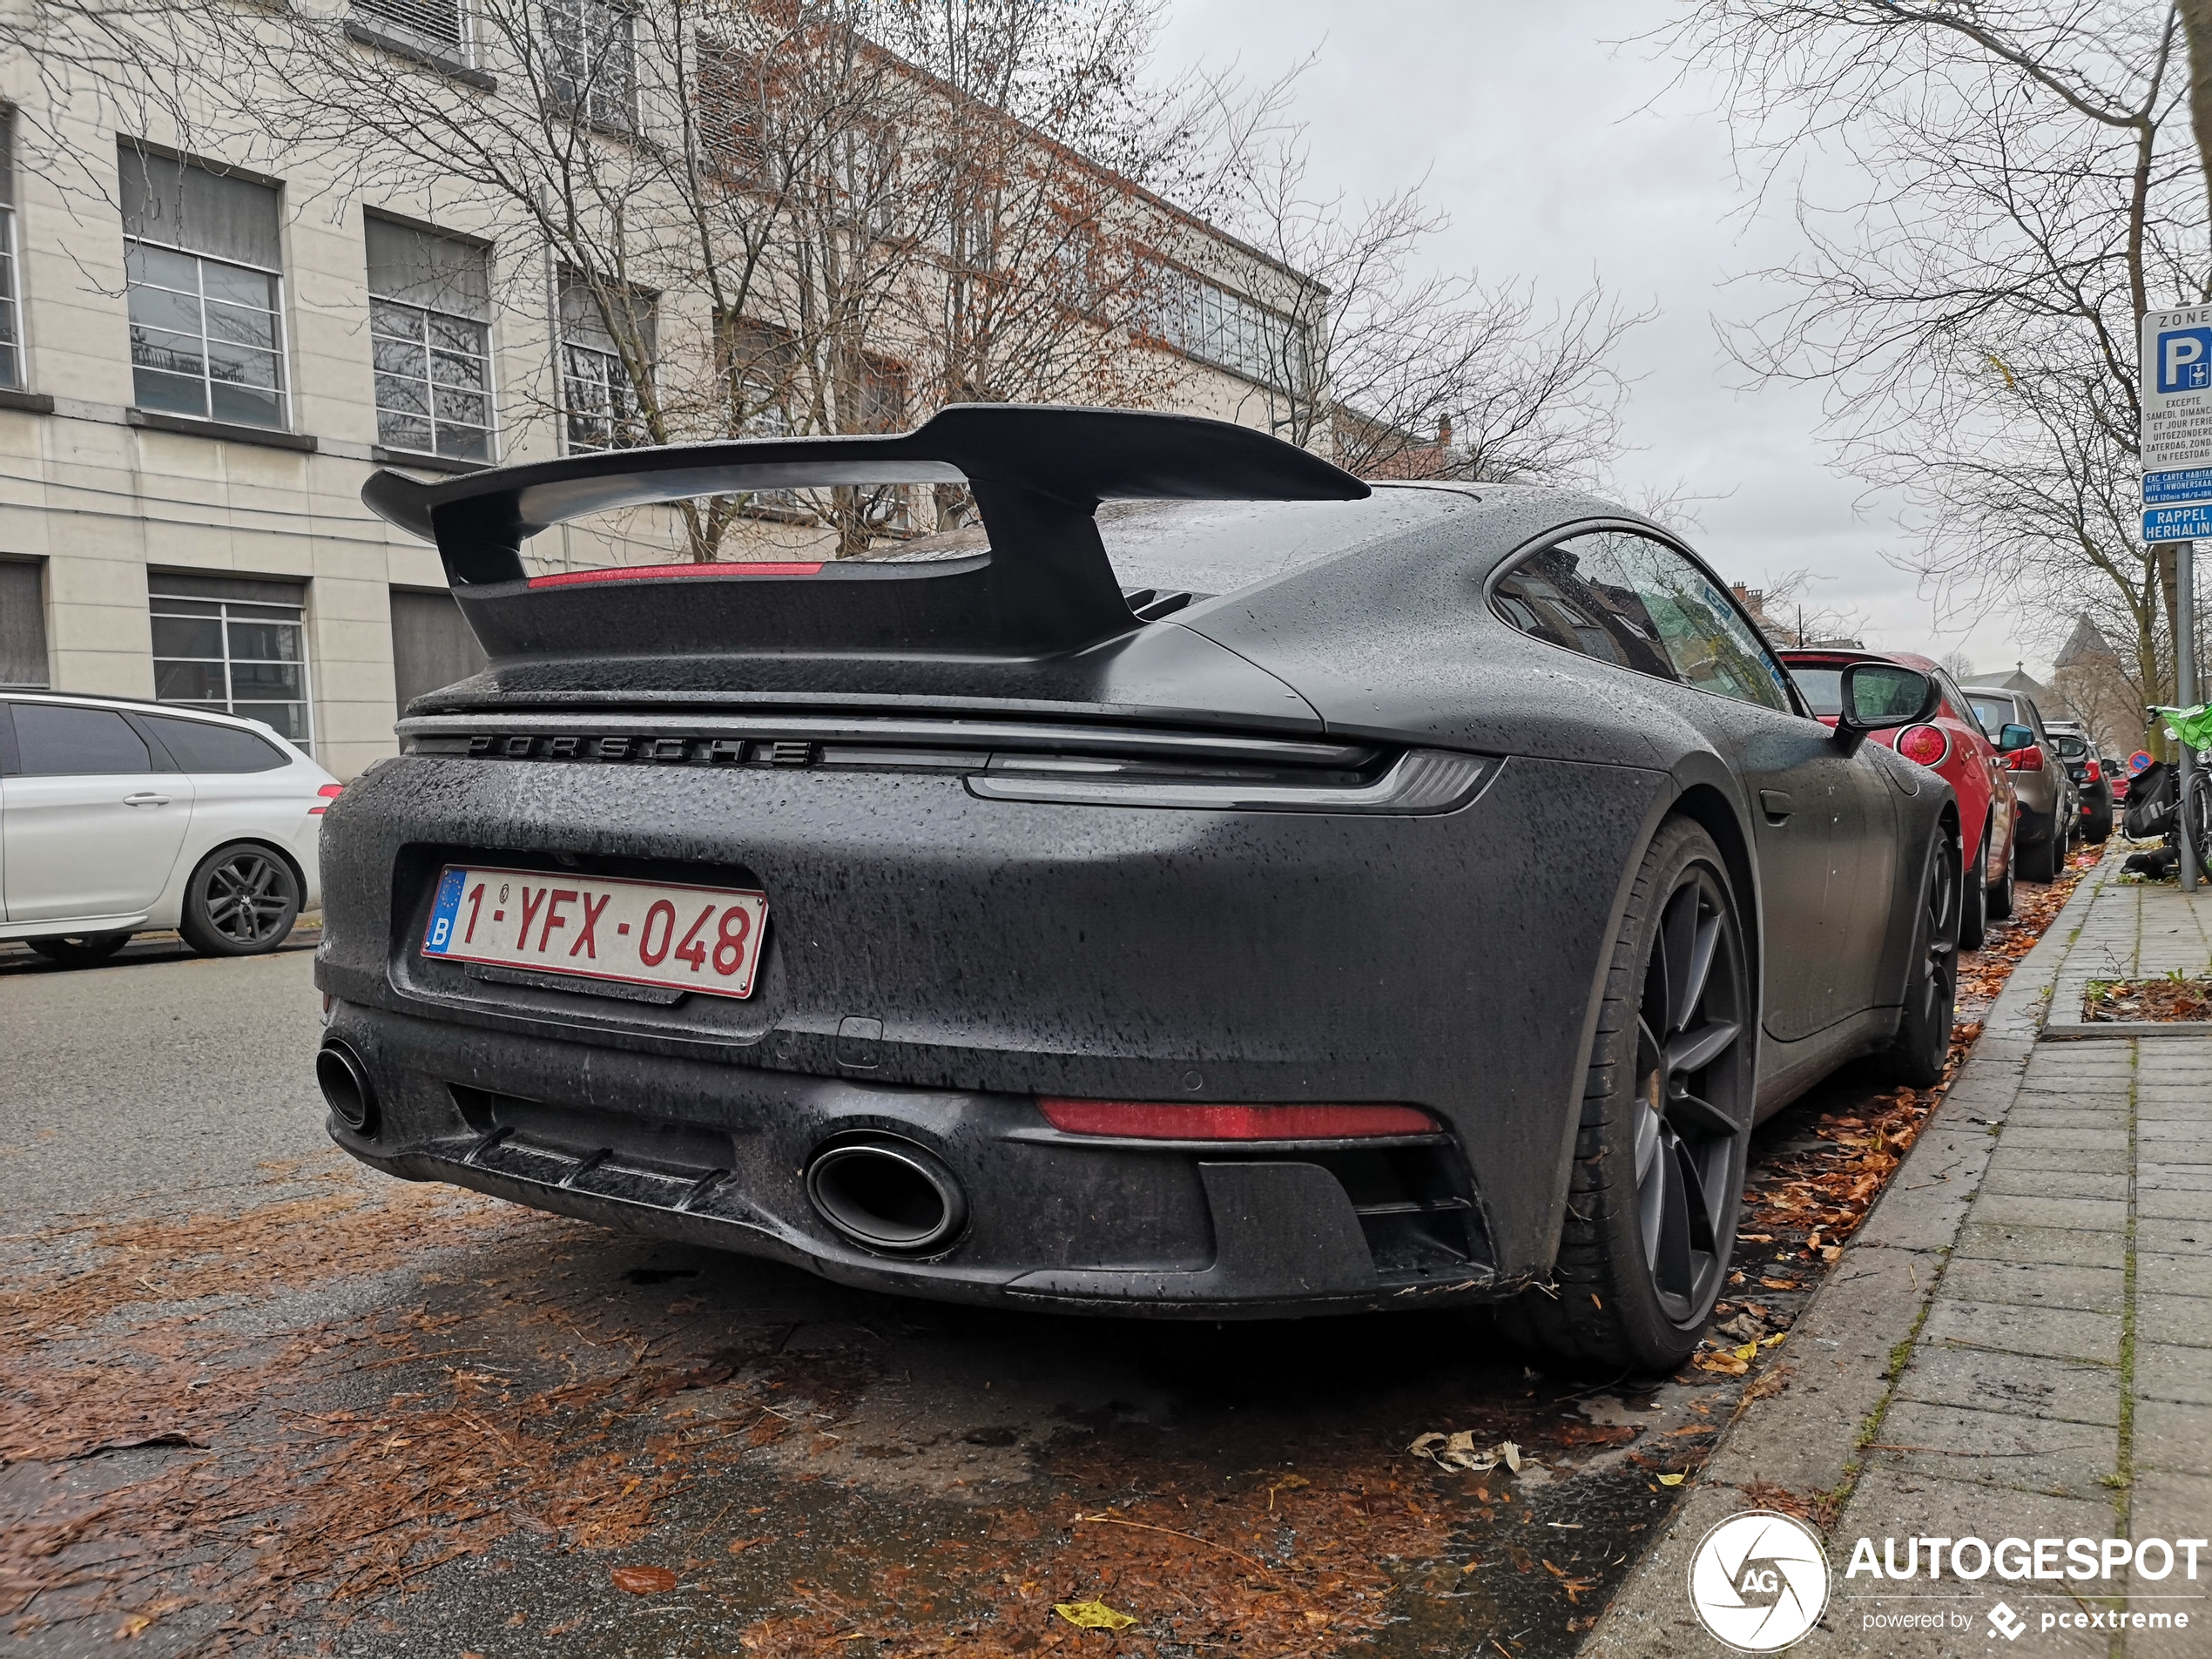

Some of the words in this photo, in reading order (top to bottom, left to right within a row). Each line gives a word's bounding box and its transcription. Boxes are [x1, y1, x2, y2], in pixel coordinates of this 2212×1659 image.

[2158, 310, 2209, 327] ZONE
[2165, 337, 2203, 386] P
[2166, 396, 2202, 408] EXCEPTE
[2146, 410, 2177, 421] SAMEDI,
[2180, 406, 2212, 417] DIMANC
[2166, 420, 2187, 428] JOUR
[2154, 428, 2212, 441] UITGEZONDERD
[2146, 442, 2188, 452] ZATERDAG,
[2169, 448, 2210, 461] FEESTDAG
[2157, 508, 2208, 524] RAPPEL
[2146, 521, 2212, 539] HERHALIN
[467, 736, 814, 765] PORSCHE
[431, 917, 449, 946] B
